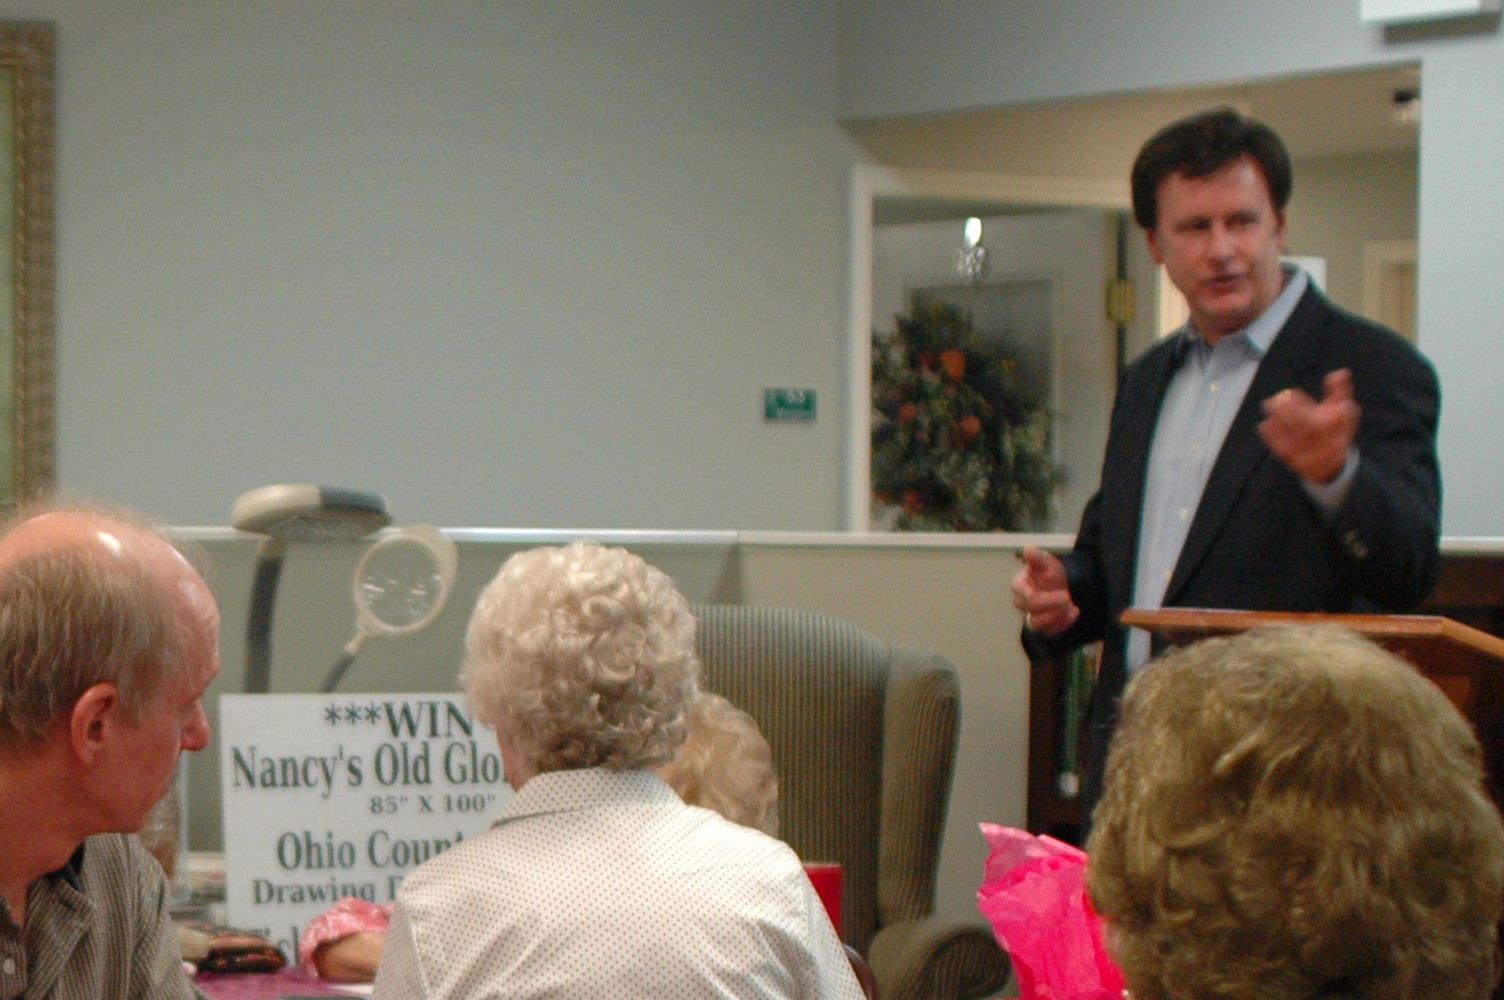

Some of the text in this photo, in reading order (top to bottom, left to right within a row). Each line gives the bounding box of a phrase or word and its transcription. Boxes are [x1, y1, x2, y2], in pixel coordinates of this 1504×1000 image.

[231, 745, 363, 799] Nancy's
[374, 741, 433, 786] Old
[417, 795, 434, 813] X
[276, 831, 356, 870] Ohio
[252, 877, 376, 905] Drawing
